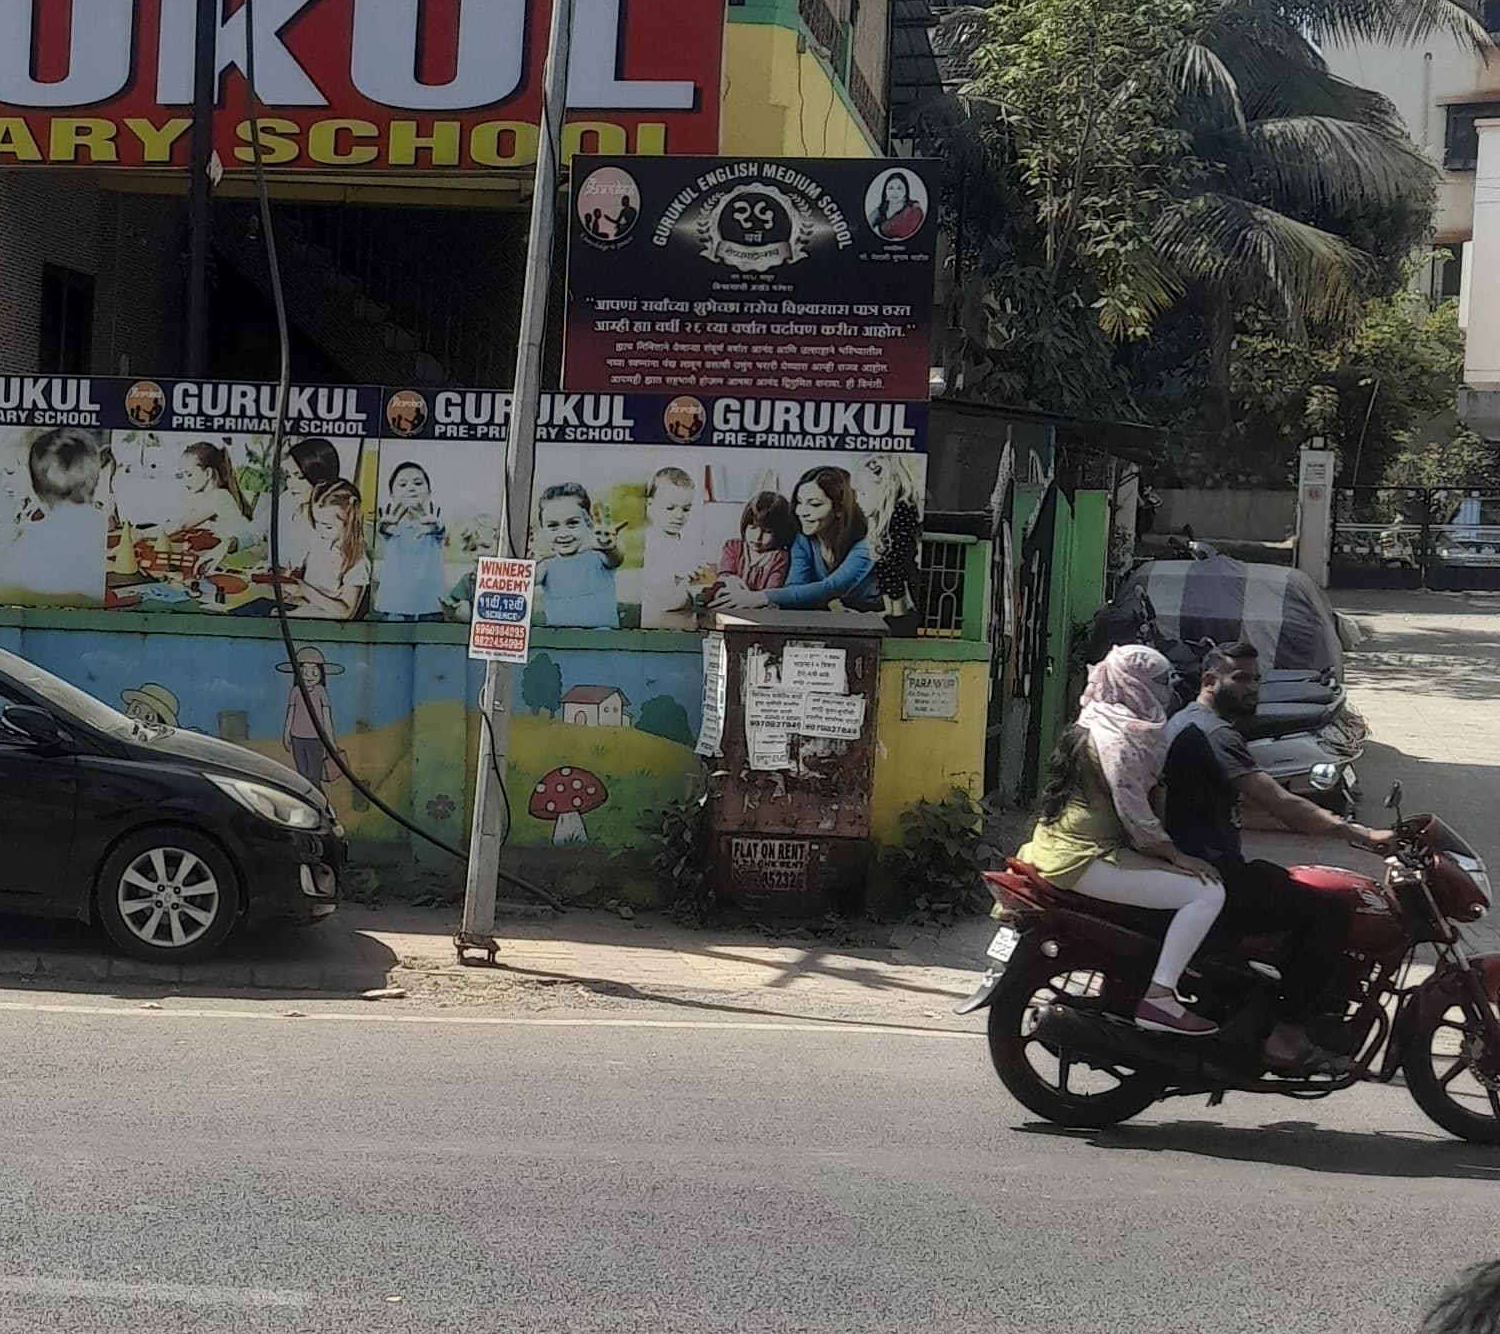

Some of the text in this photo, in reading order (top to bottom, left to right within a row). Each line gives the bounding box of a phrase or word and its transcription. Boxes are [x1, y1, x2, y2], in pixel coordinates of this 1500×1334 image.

[653, 187, 699, 247] GURUKUL
[697, 162, 759, 192] ENGLISH
[762, 163, 823, 200] MEDIUM
[817, 195, 853, 250] SCHOOL
[172, 382, 367, 420] GURUKUL
[34, 411, 101, 426] SCHOOL
[713, 398, 916, 436] GURUKUL
[299, 420, 367, 435] SCHOOL
[434, 425, 634, 441] PRE-PRIRY SCHOOL
[712, 432, 916, 451] PRE-PRIMARY SCHOOL
[481, 560, 532, 578] WINNERS
[479, 577, 531, 592] ACADEMY
[734, 841, 806, 859] FLAT ON RENT
